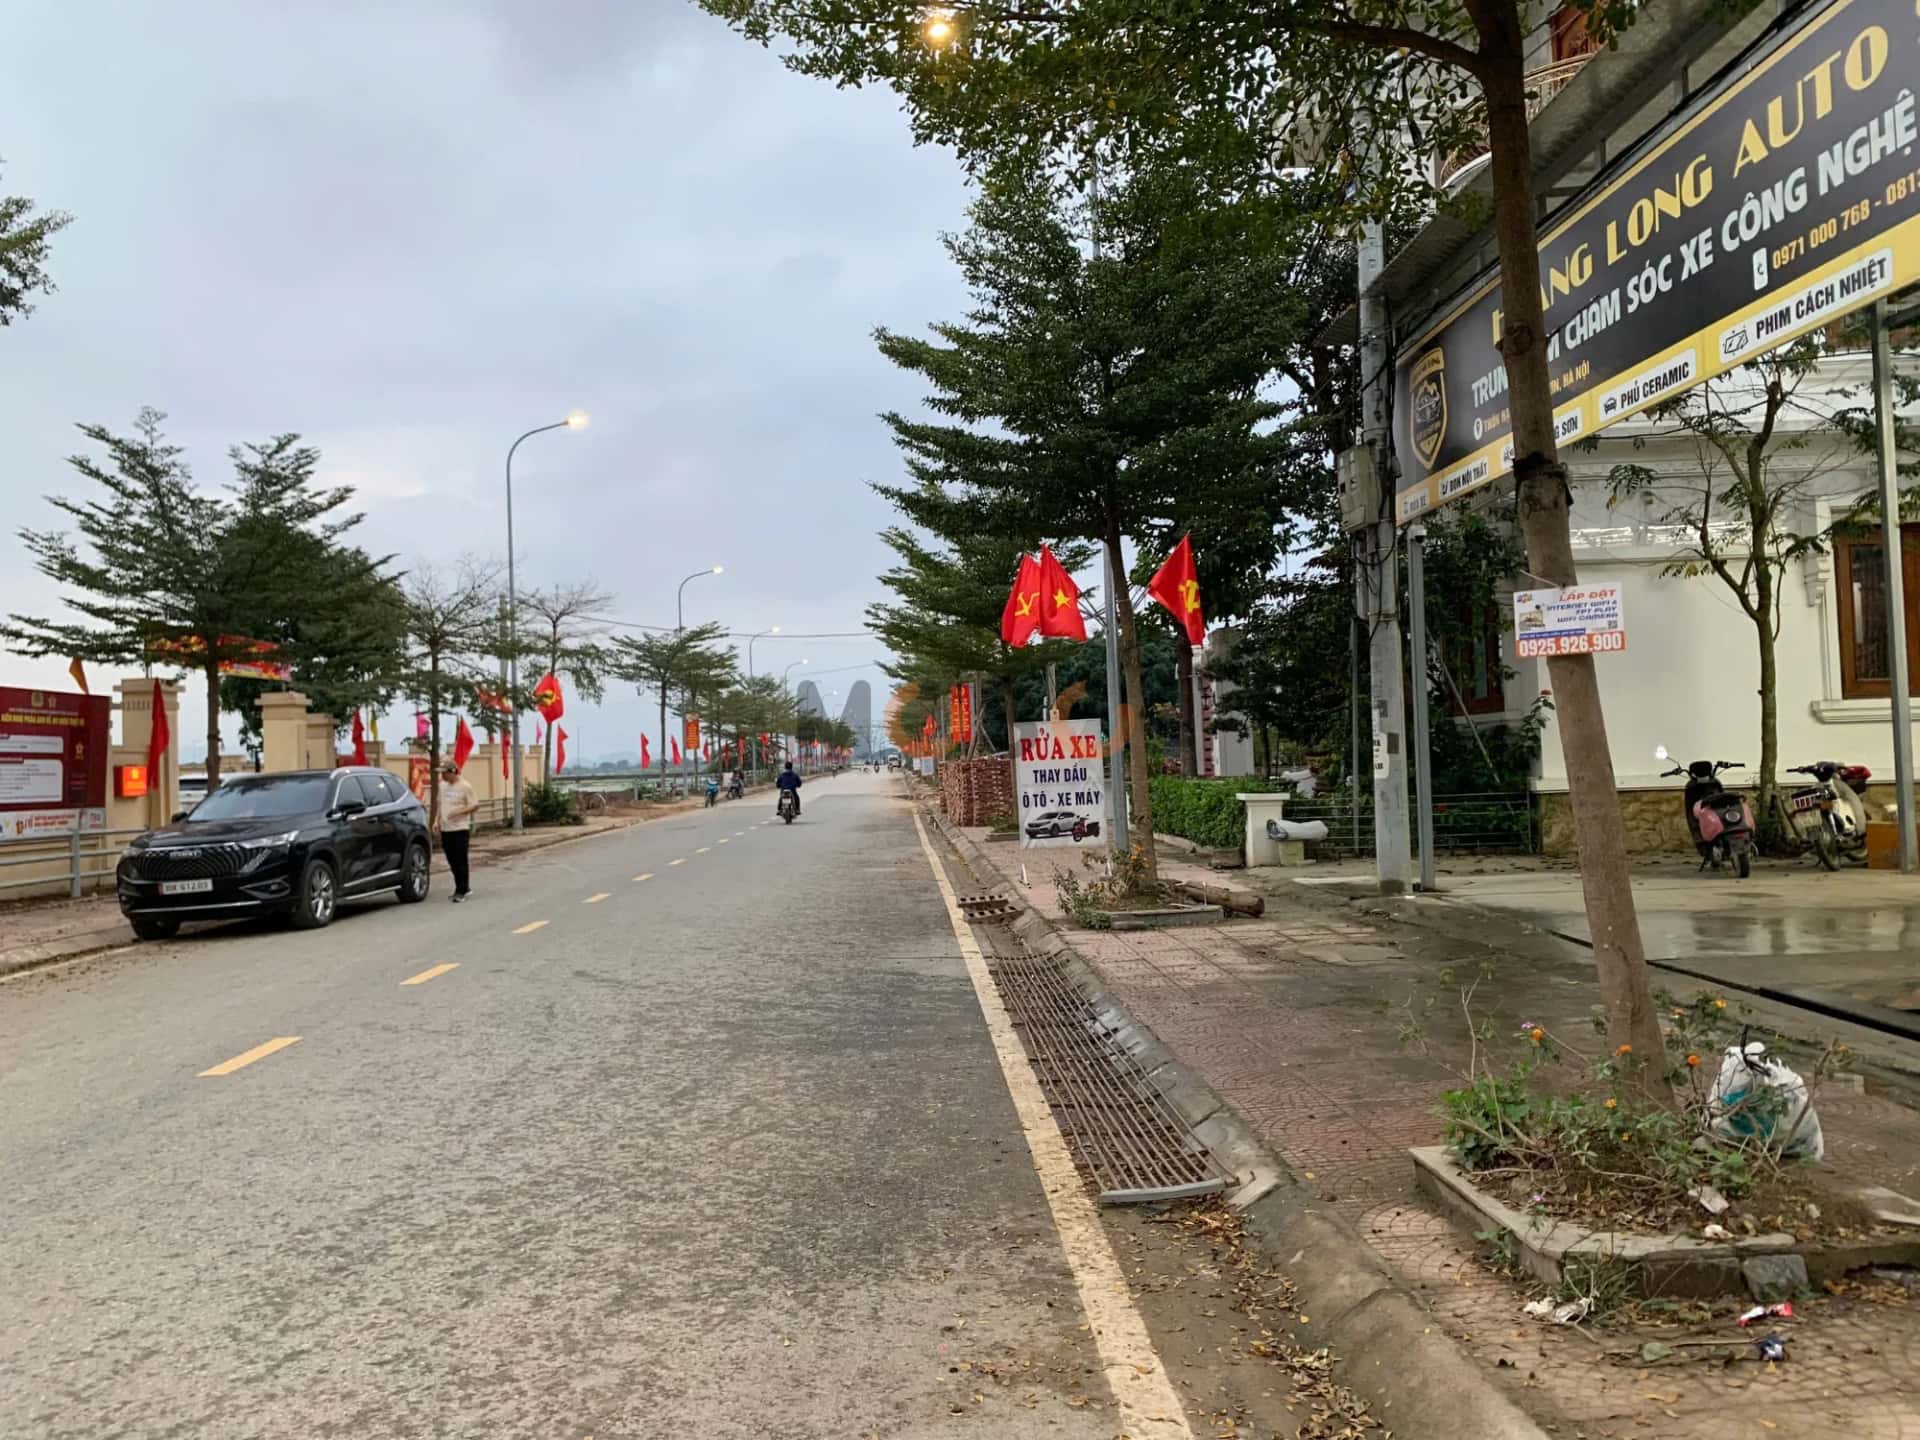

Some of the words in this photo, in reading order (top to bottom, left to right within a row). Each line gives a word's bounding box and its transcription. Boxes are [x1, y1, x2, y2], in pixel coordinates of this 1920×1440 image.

[1606, 153, 1713, 266] LONG
[1733, 25, 1889, 178] AUTO
[1627, 253, 1673, 313] SÓC
[1679, 226, 1714, 282] XE
[1722, 167, 1808, 252] CÔNG
[1817, 88, 1918, 196] NGHỆ
[1772, 236, 1805, 269] 0971
[1809, 217, 1838, 248] 000
[1841, 198, 1870, 231] 768
[1886, 168, 1920, 206] 081
[1756, 306, 1791, 339] PHIM
[1795, 284, 1835, 319] CÁCH
[1840, 257, 1887, 298] NHIỆT
[1472, 365, 1510, 408] TRUN
[1620, 379, 1640, 408] PHỦ
[1642, 361, 1690, 398] CERAMIC
[1562, 415, 1578, 435] SƠN
[1519, 632, 1622, 657] 0925.926.900
[1020, 727, 1065, 762] RỬA
[1069, 734, 1097, 759] XE
[1032, 768, 1061, 784] THAY
[1032, 790, 1047, 808] TÔ
[1057, 792, 1072, 807] XE
[1075, 788, 1100, 806] MÁY
